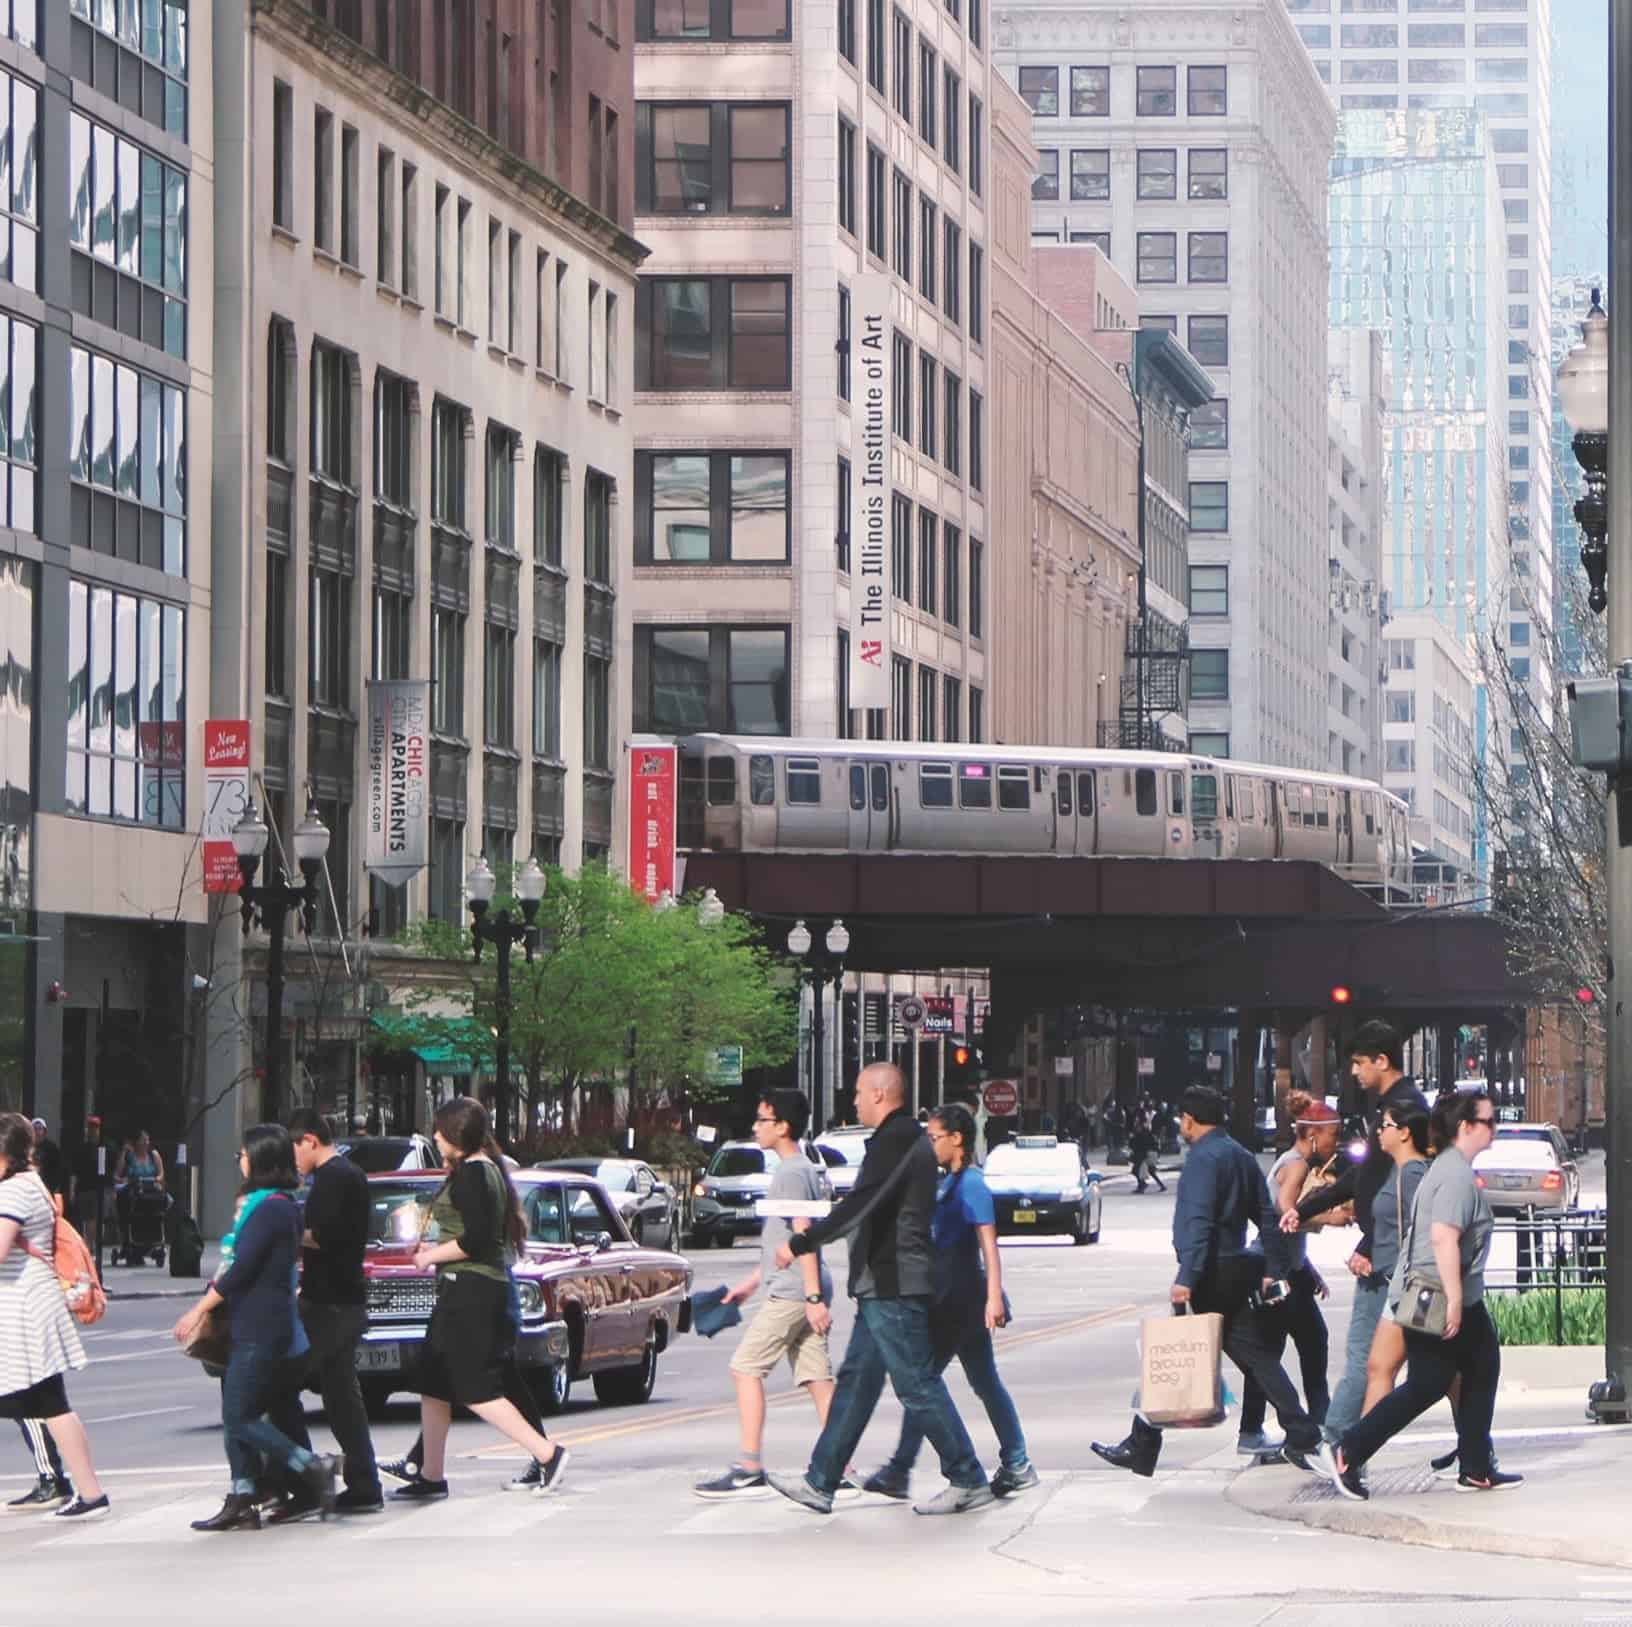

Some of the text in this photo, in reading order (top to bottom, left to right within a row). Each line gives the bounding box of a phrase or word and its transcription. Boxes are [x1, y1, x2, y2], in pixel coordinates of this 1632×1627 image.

[861, 314, 882, 350] Art
[861, 358, 882, 379] of
[861, 387, 882, 486] Institute
[861, 495, 882, 576] Illinois
[861, 584, 882, 627] The
[217, 732, 236, 745] New
[208, 741, 246, 761] Leasing!
[370, 717, 384, 833] villagegreen.com
[207, 779, 246, 815] 73
[925, 1016, 953, 1027] Nails
[1150, 1339, 1208, 1354] medium
[1150, 1357, 1195, 1371] brown
[1150, 1371, 1180, 1385] bag
